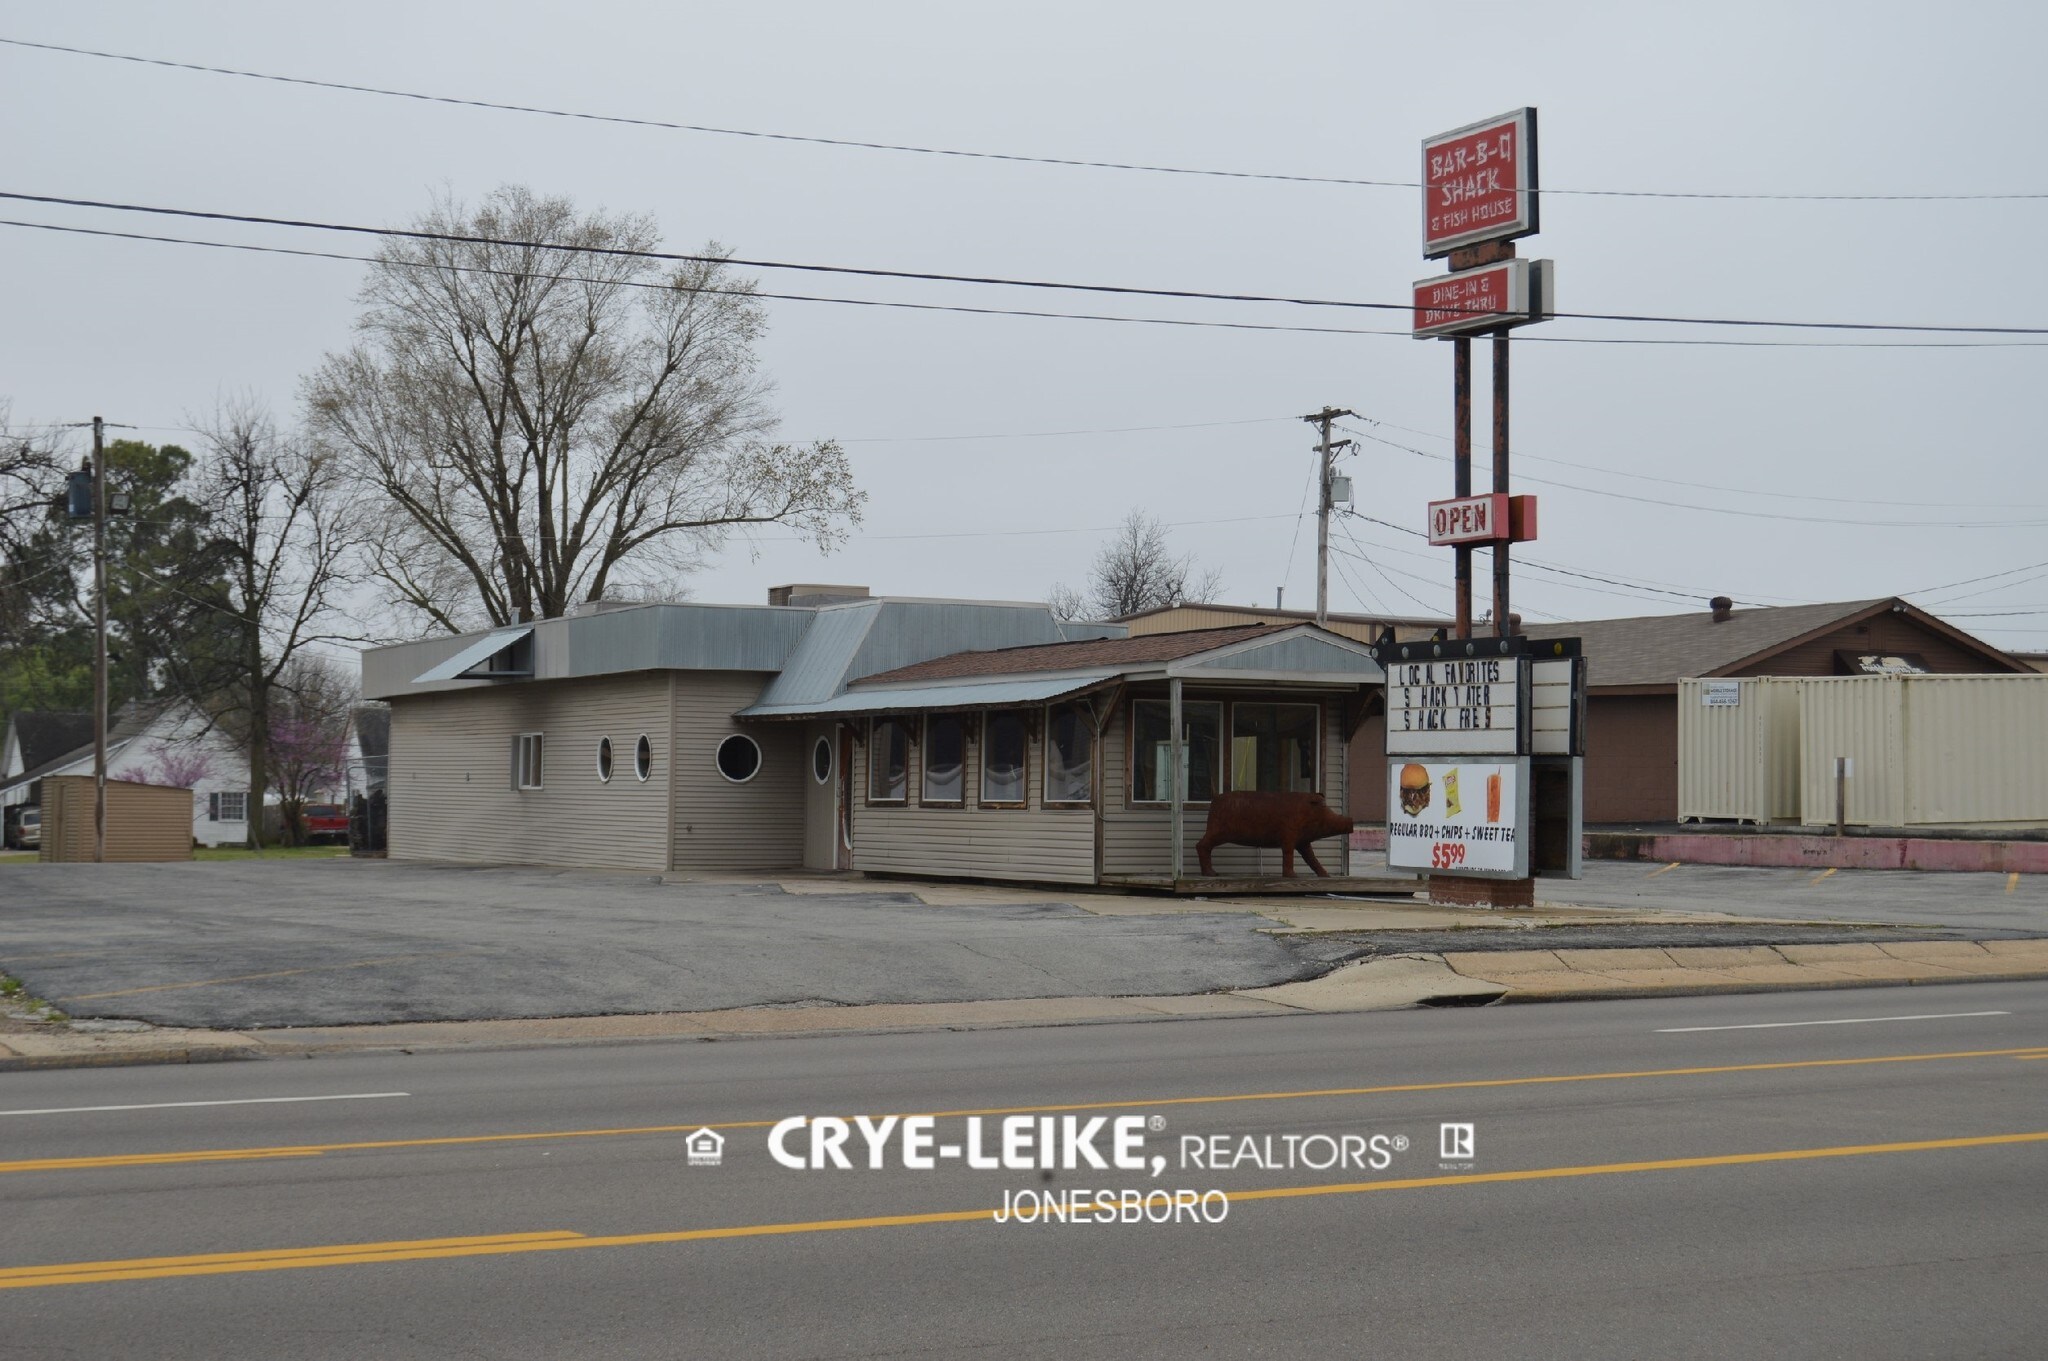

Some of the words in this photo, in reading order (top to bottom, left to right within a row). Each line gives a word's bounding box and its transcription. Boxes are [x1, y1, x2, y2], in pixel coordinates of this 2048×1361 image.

[1431, 133, 1511, 180] BAR-B-Q
[1442, 167, 1500, 206] SHACK
[1432, 216, 1440, 231] &
[1443, 209, 1468, 230] FISH
[1472, 197, 1512, 222] HOUSE
[1433, 281, 1477, 304] DINE-IN
[1481, 277, 1489, 292] &
[1426, 301, 1461, 323] DRIVE
[1464, 294, 1496, 316] THRU
[1435, 502, 1486, 536] OPEN
[1400, 664, 1435, 685] LOCAL
[1445, 661, 1499, 684] FAVORITES
[1390, 822, 1417, 838] REGULAR
[1442, 826, 1463, 839] CHIPS
[1472, 826, 1499, 842] SWEET
